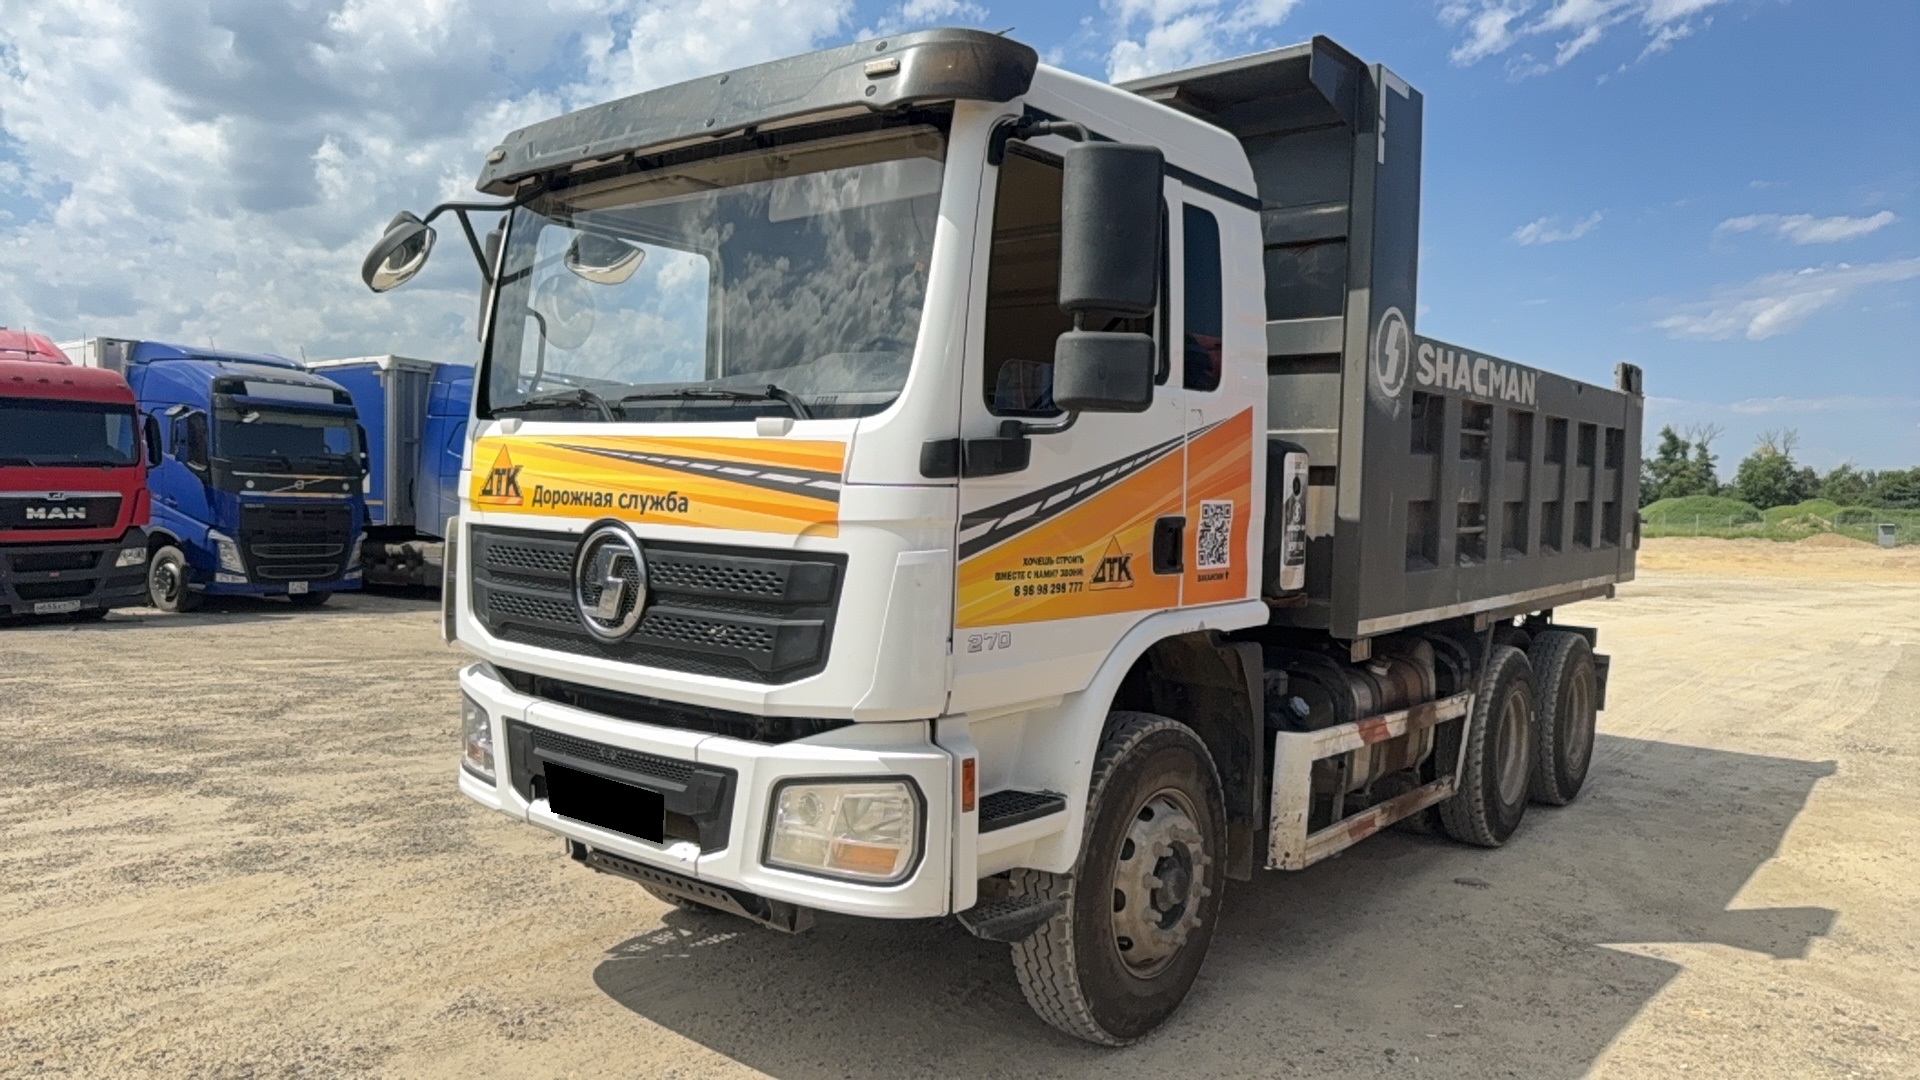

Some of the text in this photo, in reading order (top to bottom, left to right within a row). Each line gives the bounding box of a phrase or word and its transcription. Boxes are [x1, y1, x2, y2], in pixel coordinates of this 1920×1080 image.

[1416, 343, 1536, 405] SHACMAN
[481, 466, 523, 497] ДТК
[532, 485, 689, 514] Дорожная служба
[26, 507, 86, 519] MAN
[1023, 555, 1084, 567] ХОЧЕШЬ СТРОИТЬ
[1092, 556, 1133, 582] ДТК
[995, 571, 1026, 581] ВМЕСТЕ
[1027, 571, 1032, 579] С
[1034, 570, 1059, 579] НАМИ?
[1014, 585, 1020, 597] 8
[1069, 581, 1084, 593] 777
[967, 631, 1012, 653] 270
